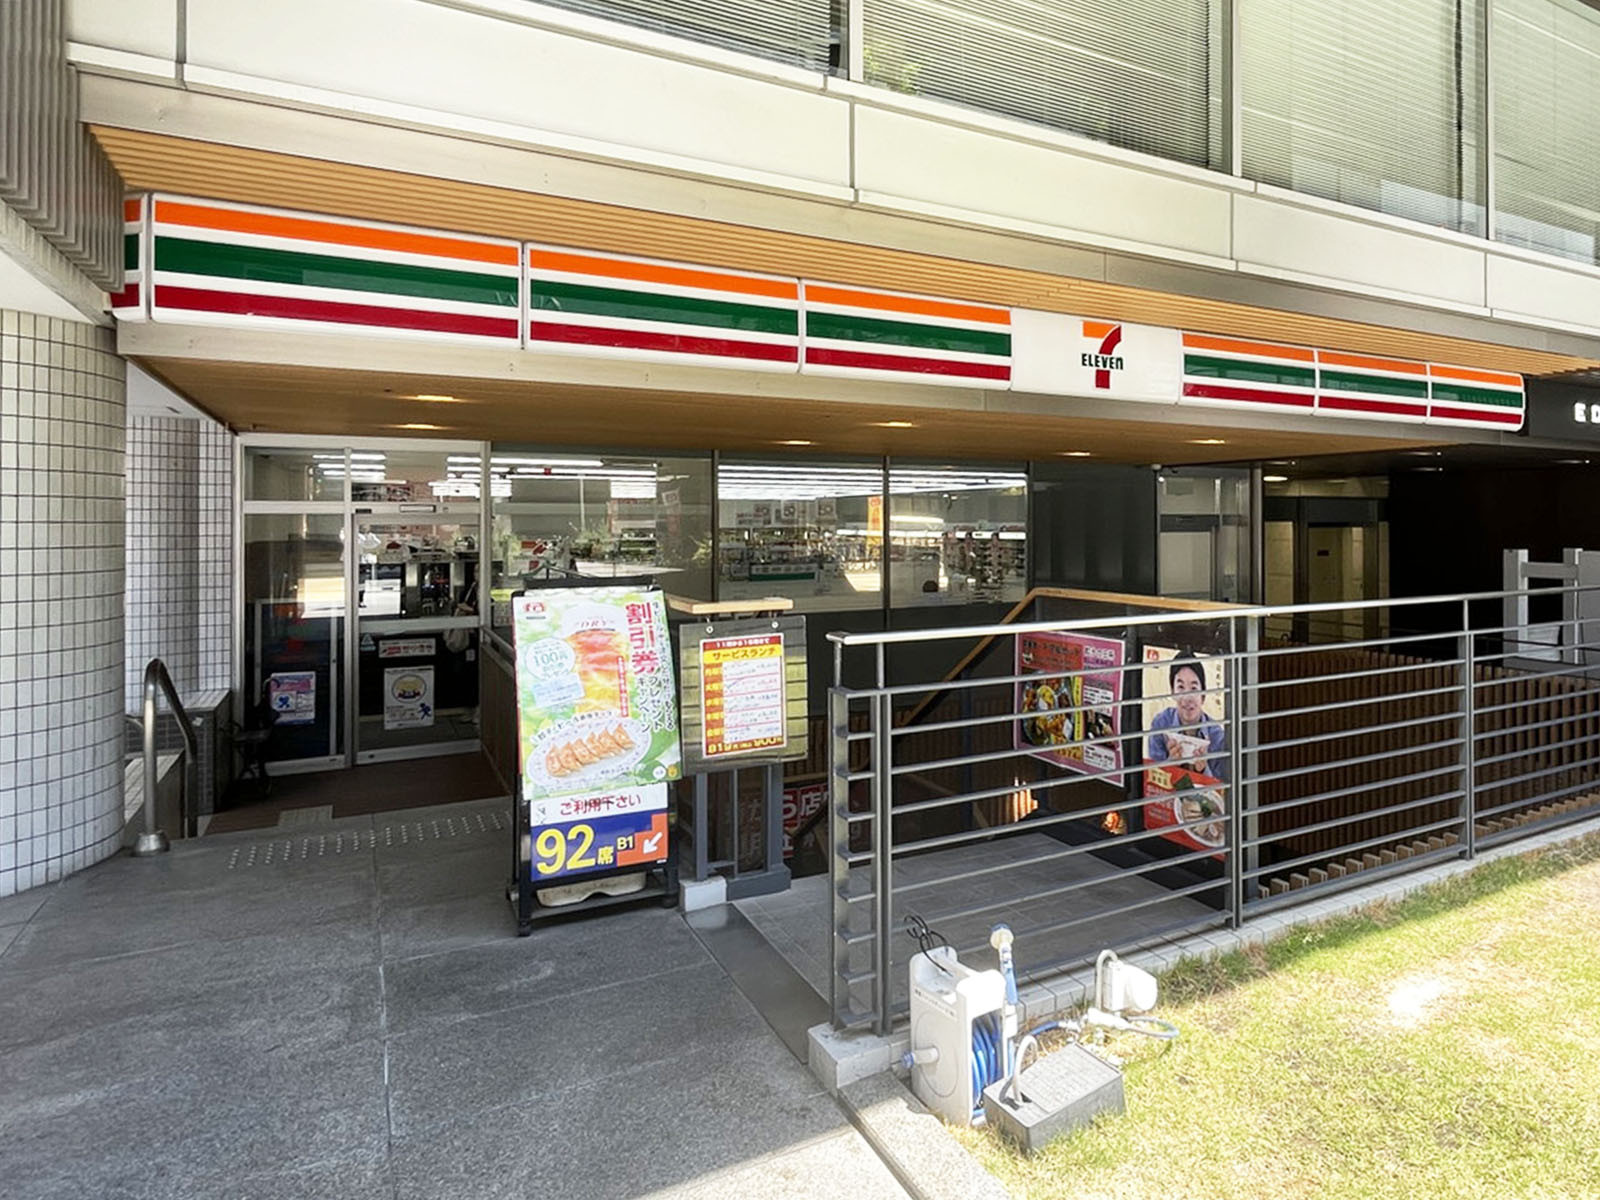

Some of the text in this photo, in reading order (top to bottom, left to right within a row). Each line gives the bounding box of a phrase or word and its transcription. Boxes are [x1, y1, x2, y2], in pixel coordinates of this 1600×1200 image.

[1083, 320, 1121, 389] 7
[625, 602, 659, 675] 割引券
[712, 647, 776, 661] サービスランチ
[560, 794, 641, 816] ご利用下さい
[617, 835, 634, 850] B1
